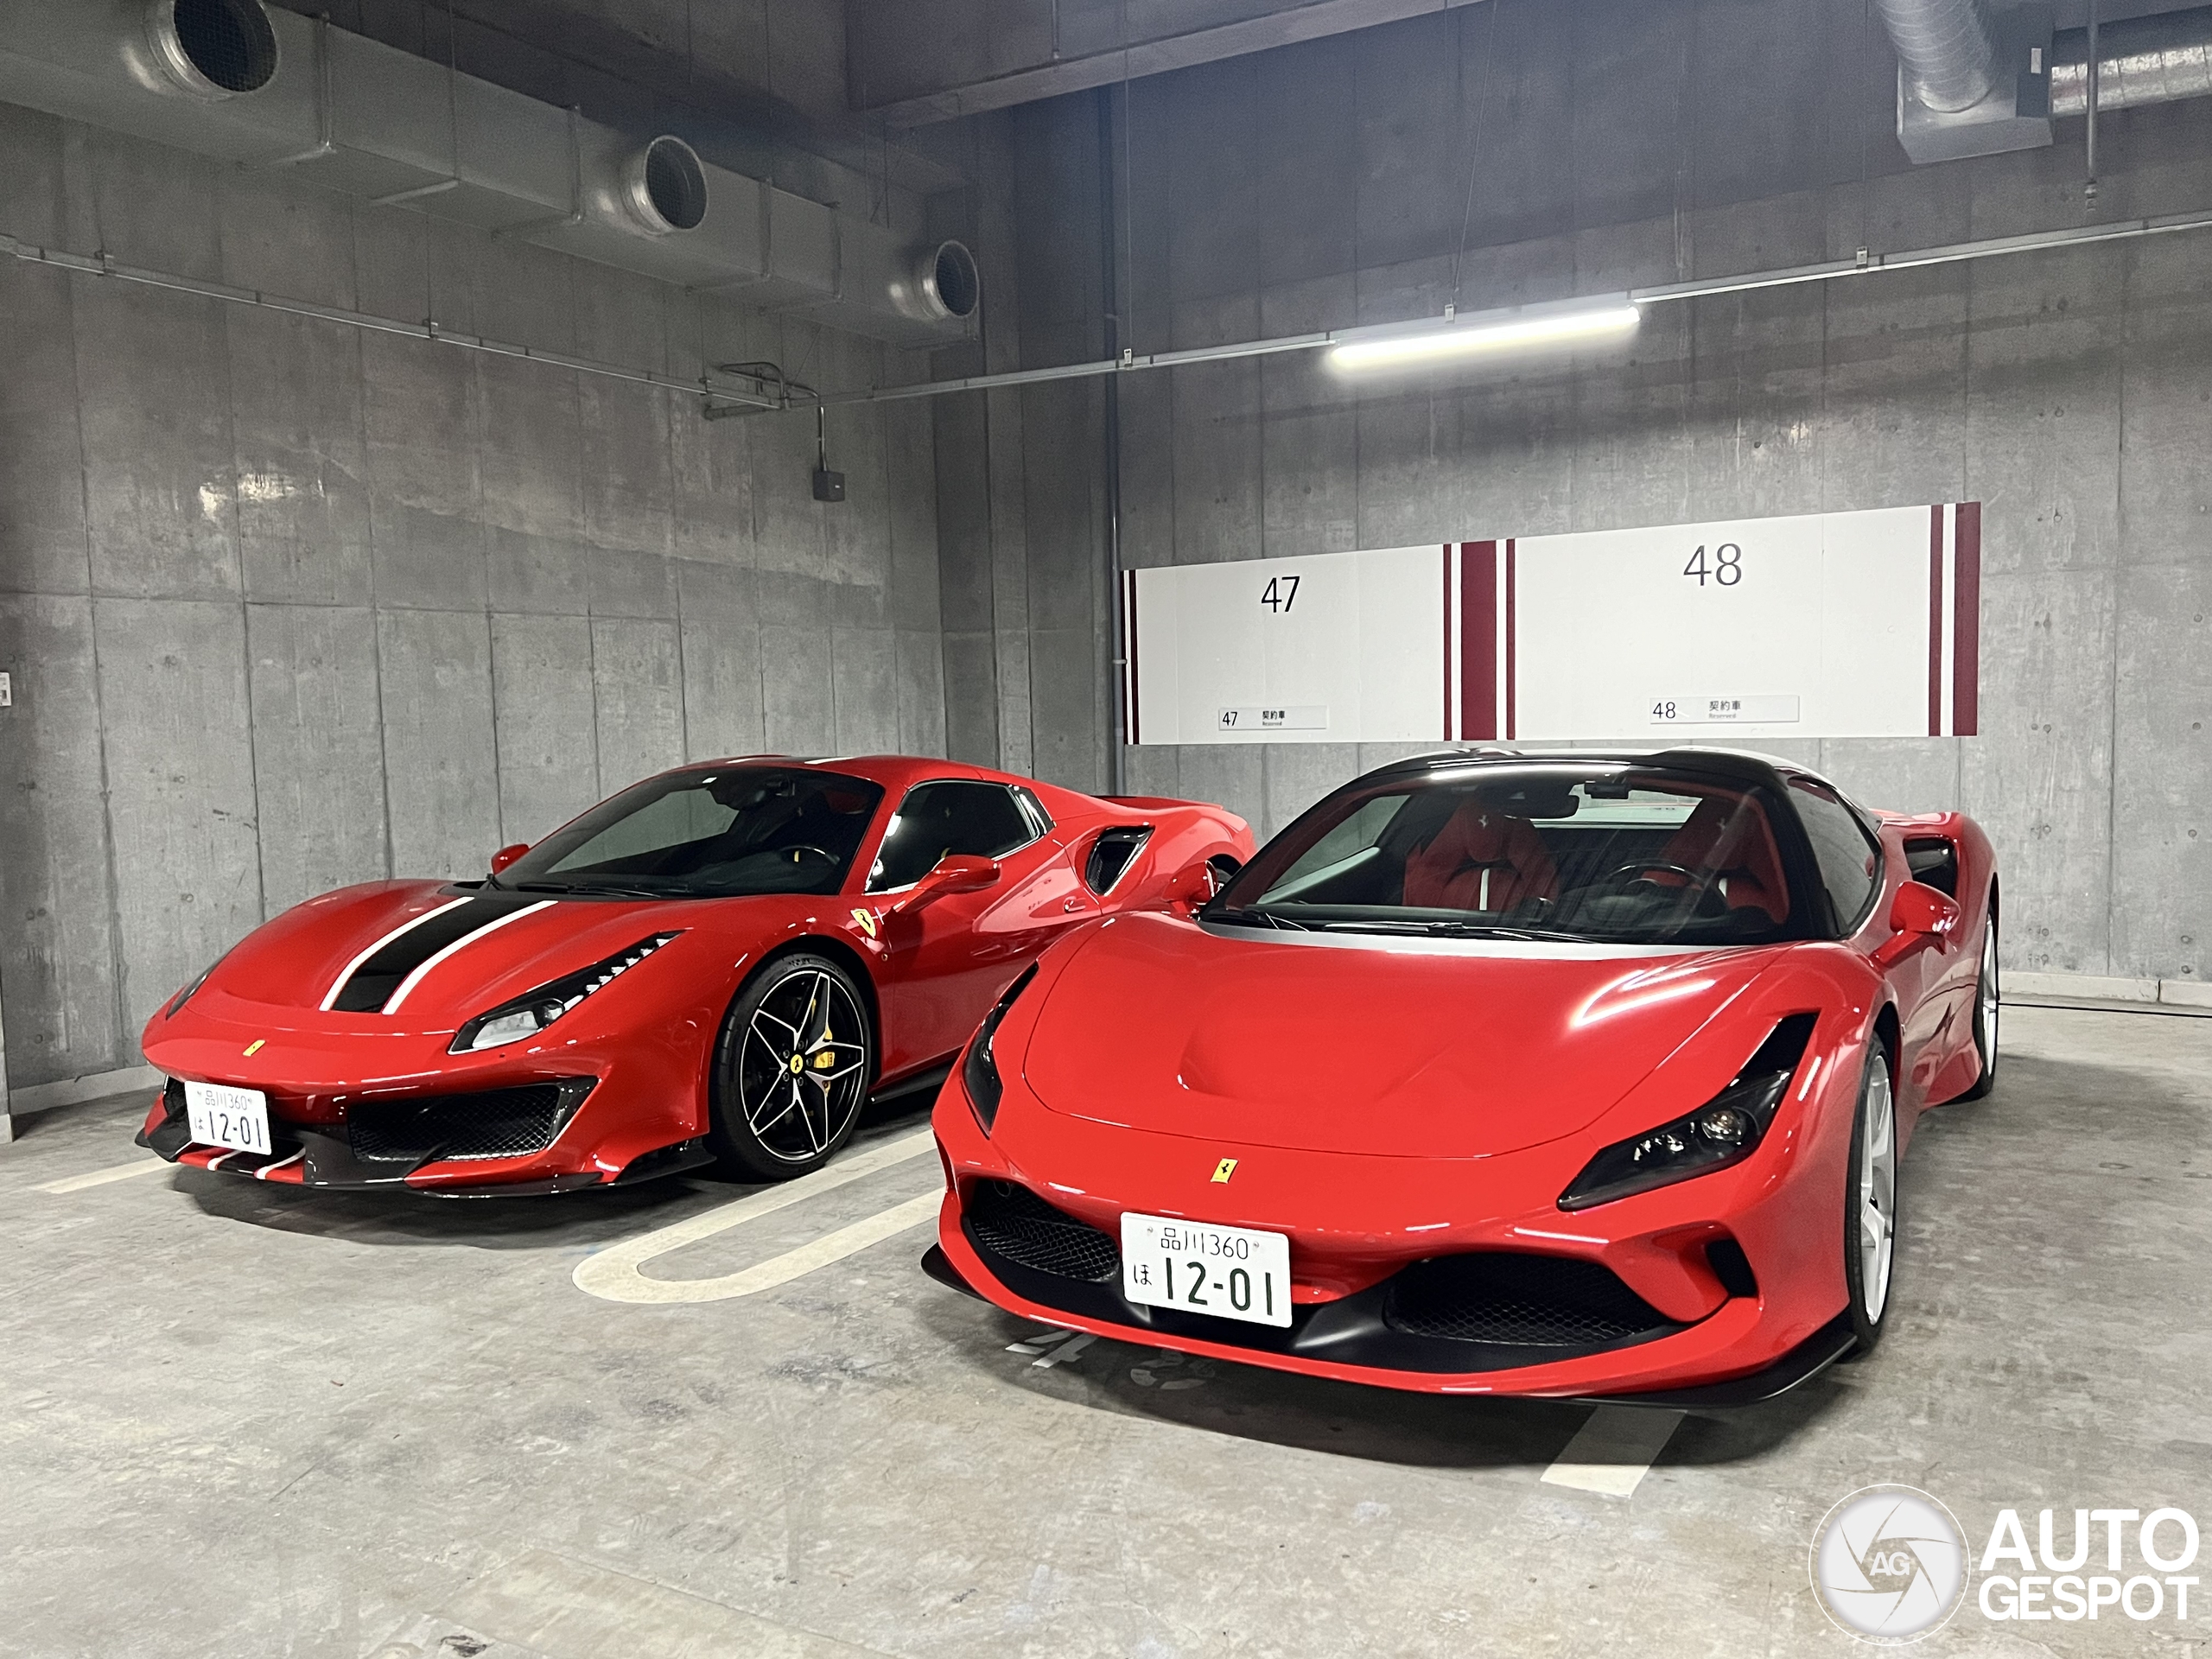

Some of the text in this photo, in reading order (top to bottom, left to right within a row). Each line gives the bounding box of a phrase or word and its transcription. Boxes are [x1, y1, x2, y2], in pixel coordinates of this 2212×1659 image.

[1683, 543, 1742, 586] 48
[1262, 575, 1300, 613] 47
[1222, 710, 1285, 726] 47 契約車
[1652, 700, 1741, 719] 48 契約車
[209, 1111, 262, 1147] 12-01
[1134, 1257, 1273, 1316] ほ 12-01
